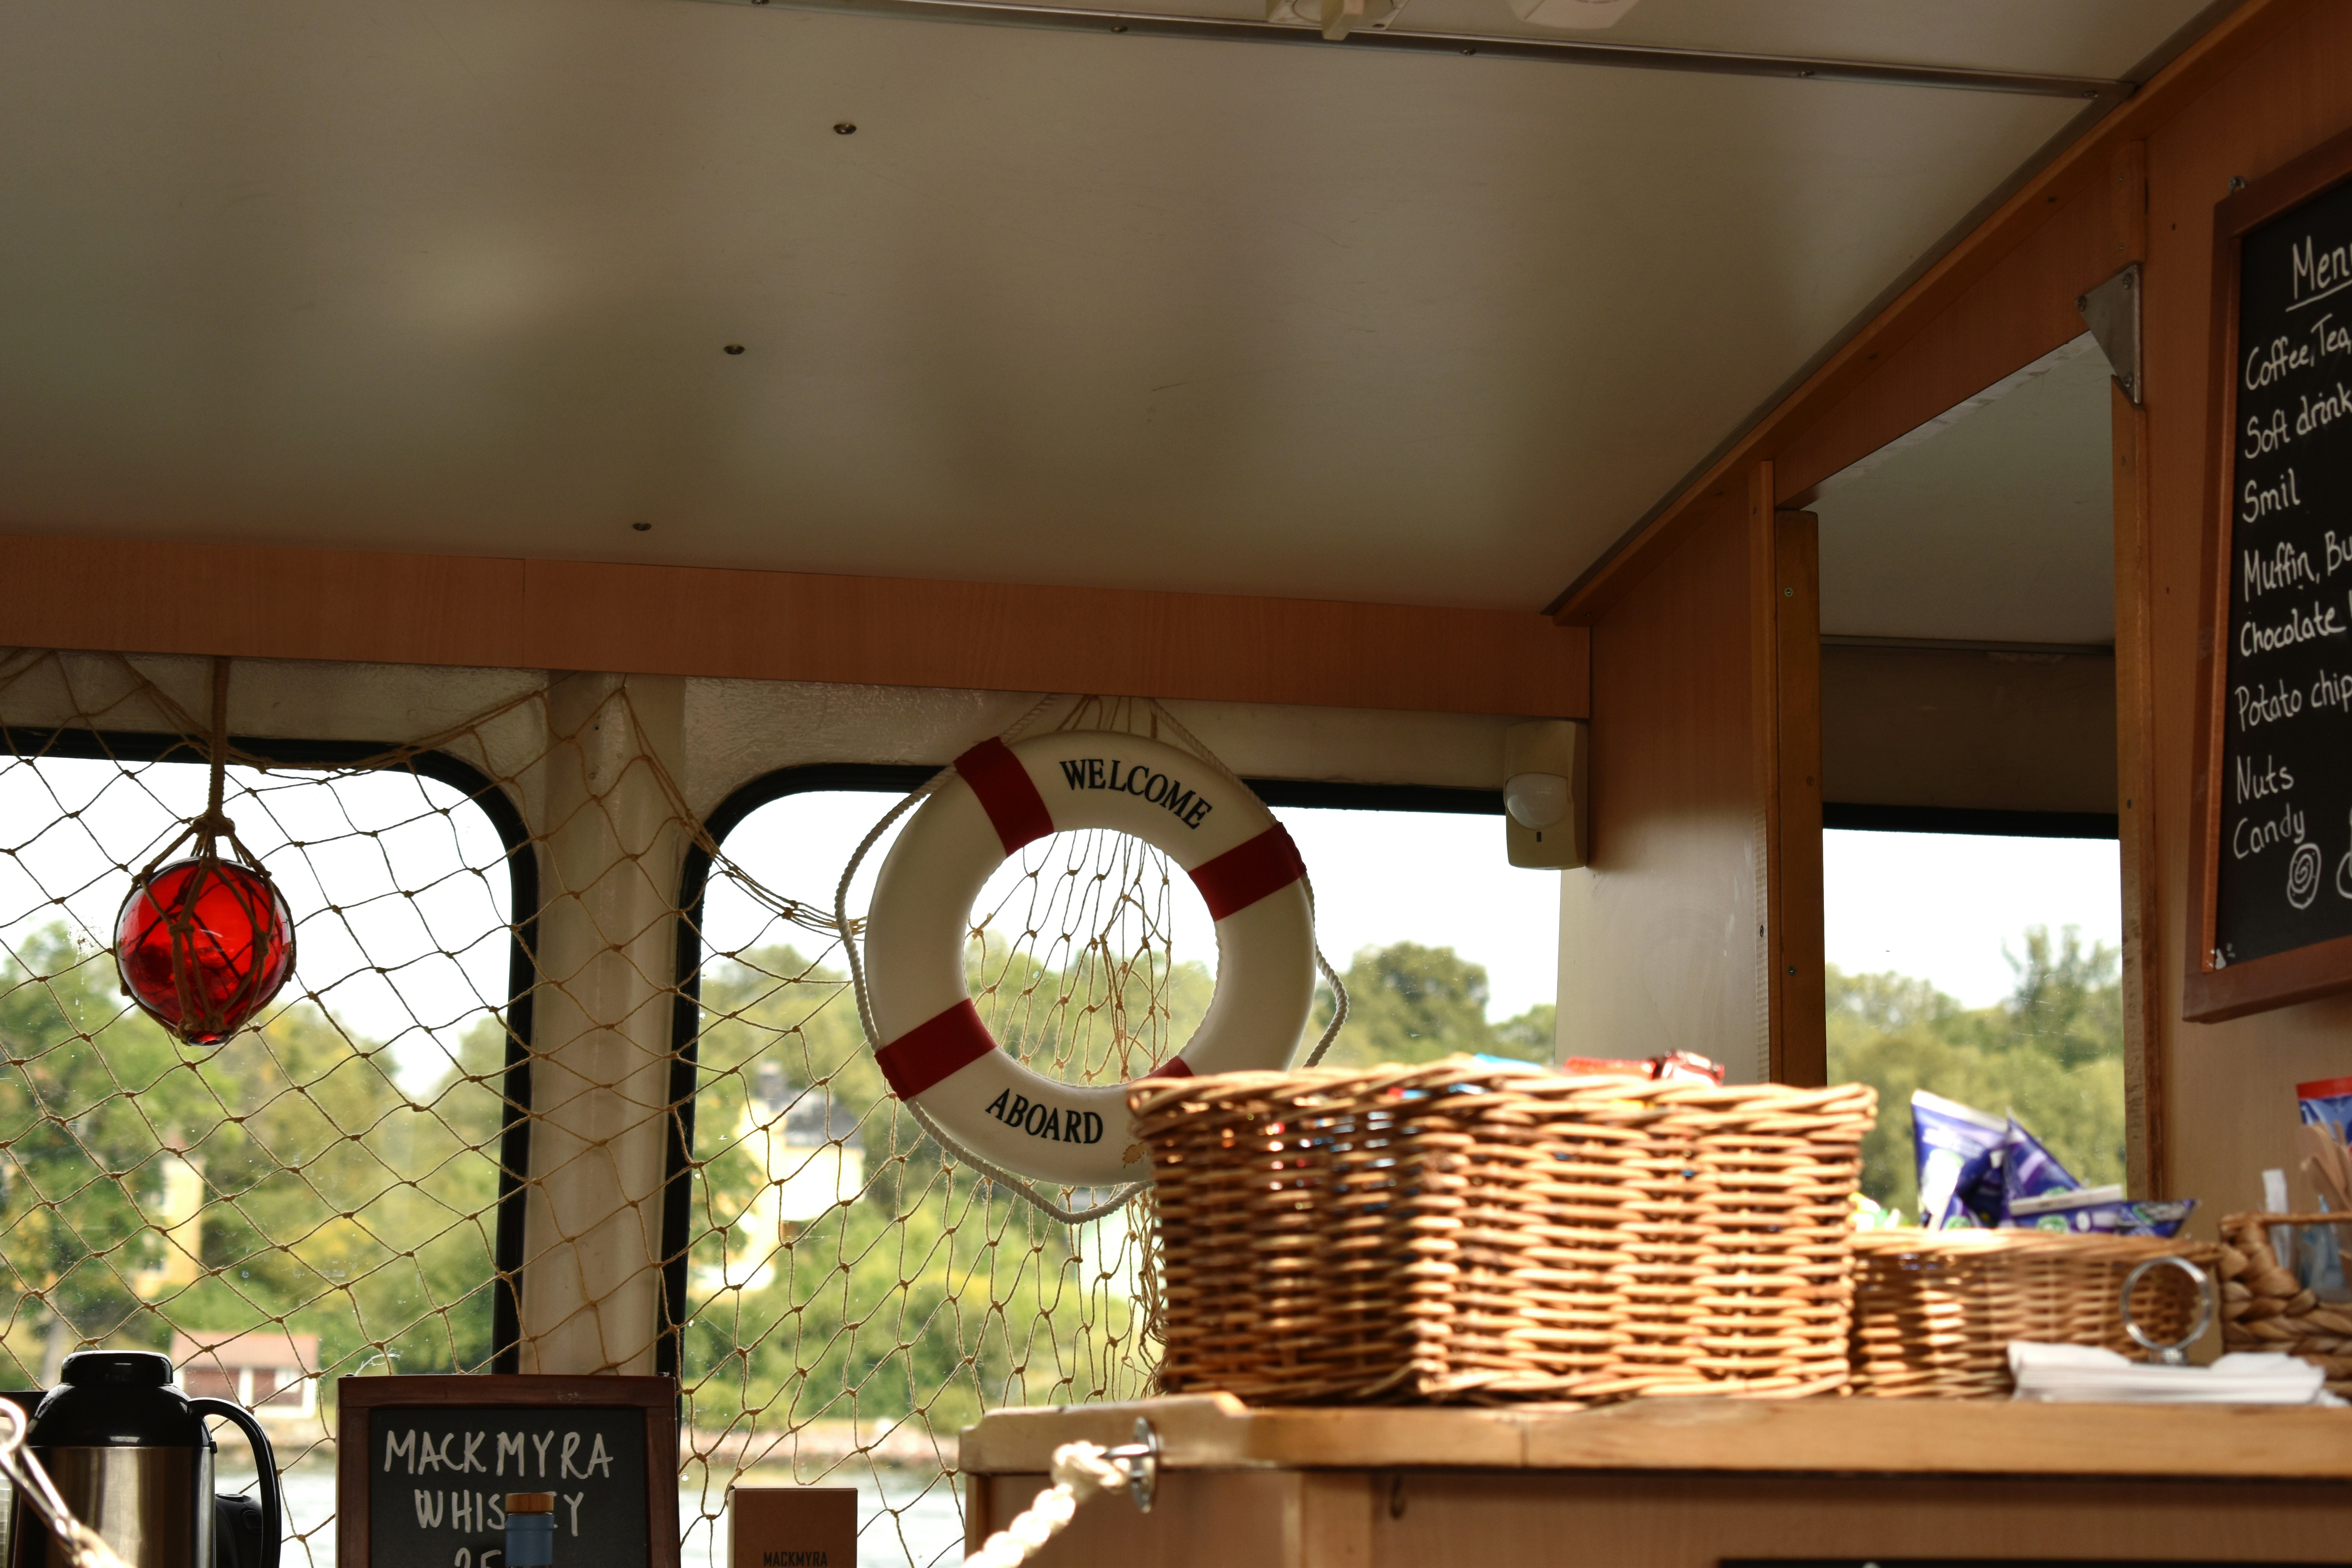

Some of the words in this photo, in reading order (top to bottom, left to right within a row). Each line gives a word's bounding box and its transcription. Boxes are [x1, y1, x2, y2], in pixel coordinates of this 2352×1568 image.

[2292, 235, 2352, 300] Men
[2245, 336, 2315, 391] Coffee,
[2244, 408, 2291, 459] Soft
[2242, 468, 2301, 523] Smil
[2243, 541, 2320, 603] Muffin,
[2240, 600, 2347, 657] Chocolate
[2234, 679, 2302, 732] Potato
[1059, 759, 1213, 830] WELCOME
[2236, 754, 2294, 804] Nuts
[2233, 802, 2306, 860] Candy
[985, 1088, 1103, 1144] ABOARD
[383, 1429, 614, 1480] MACKMYRA
[763, 1550, 829, 1568] MACKMYRA
